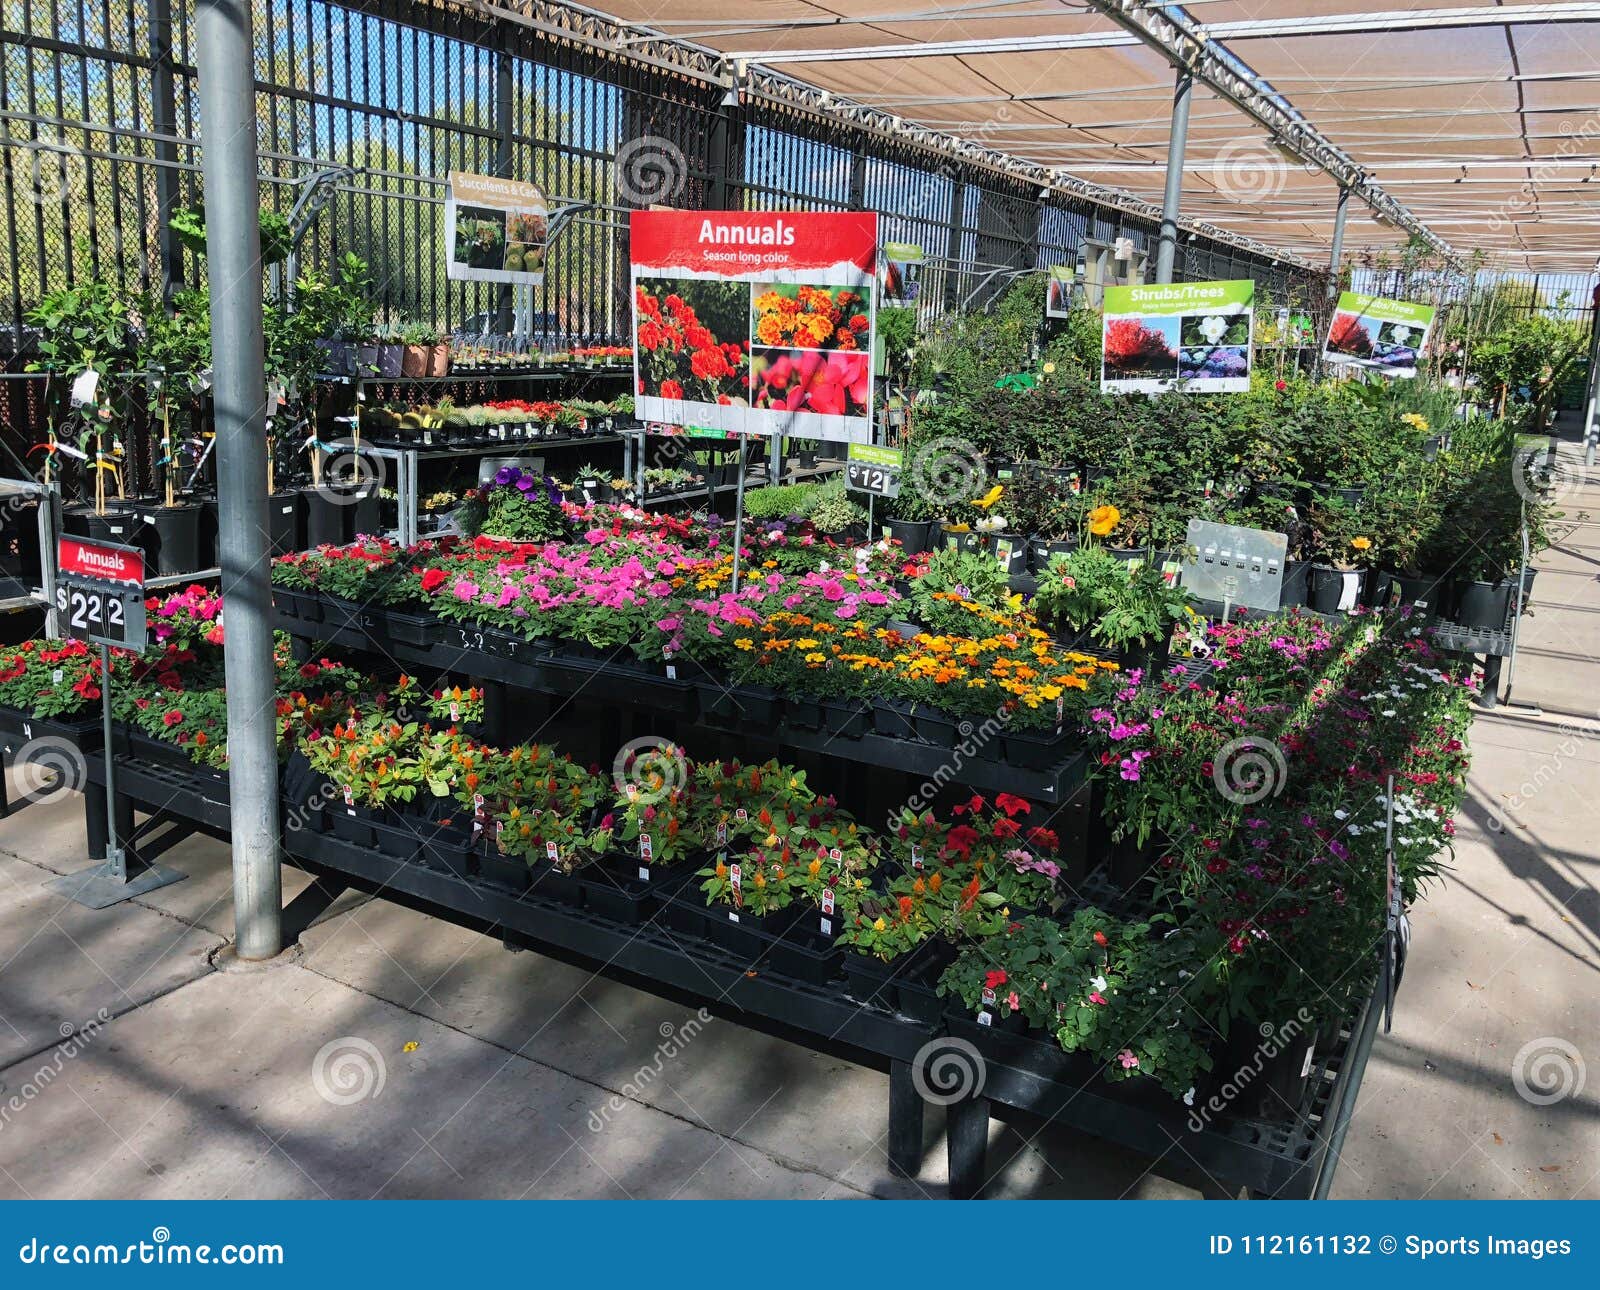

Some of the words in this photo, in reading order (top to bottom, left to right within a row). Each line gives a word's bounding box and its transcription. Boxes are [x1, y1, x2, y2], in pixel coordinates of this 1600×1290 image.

[458, 176, 508, 194] Succulents
[510, 183, 518, 195] &
[698, 219, 795, 245] Annuals
[703, 249, 736, 261] Season
[739, 251, 760, 265] long
[764, 251, 788, 263] color
[1131, 286, 1225, 301] Shrubs/Trees
[77, 547, 125, 570] Annuals
